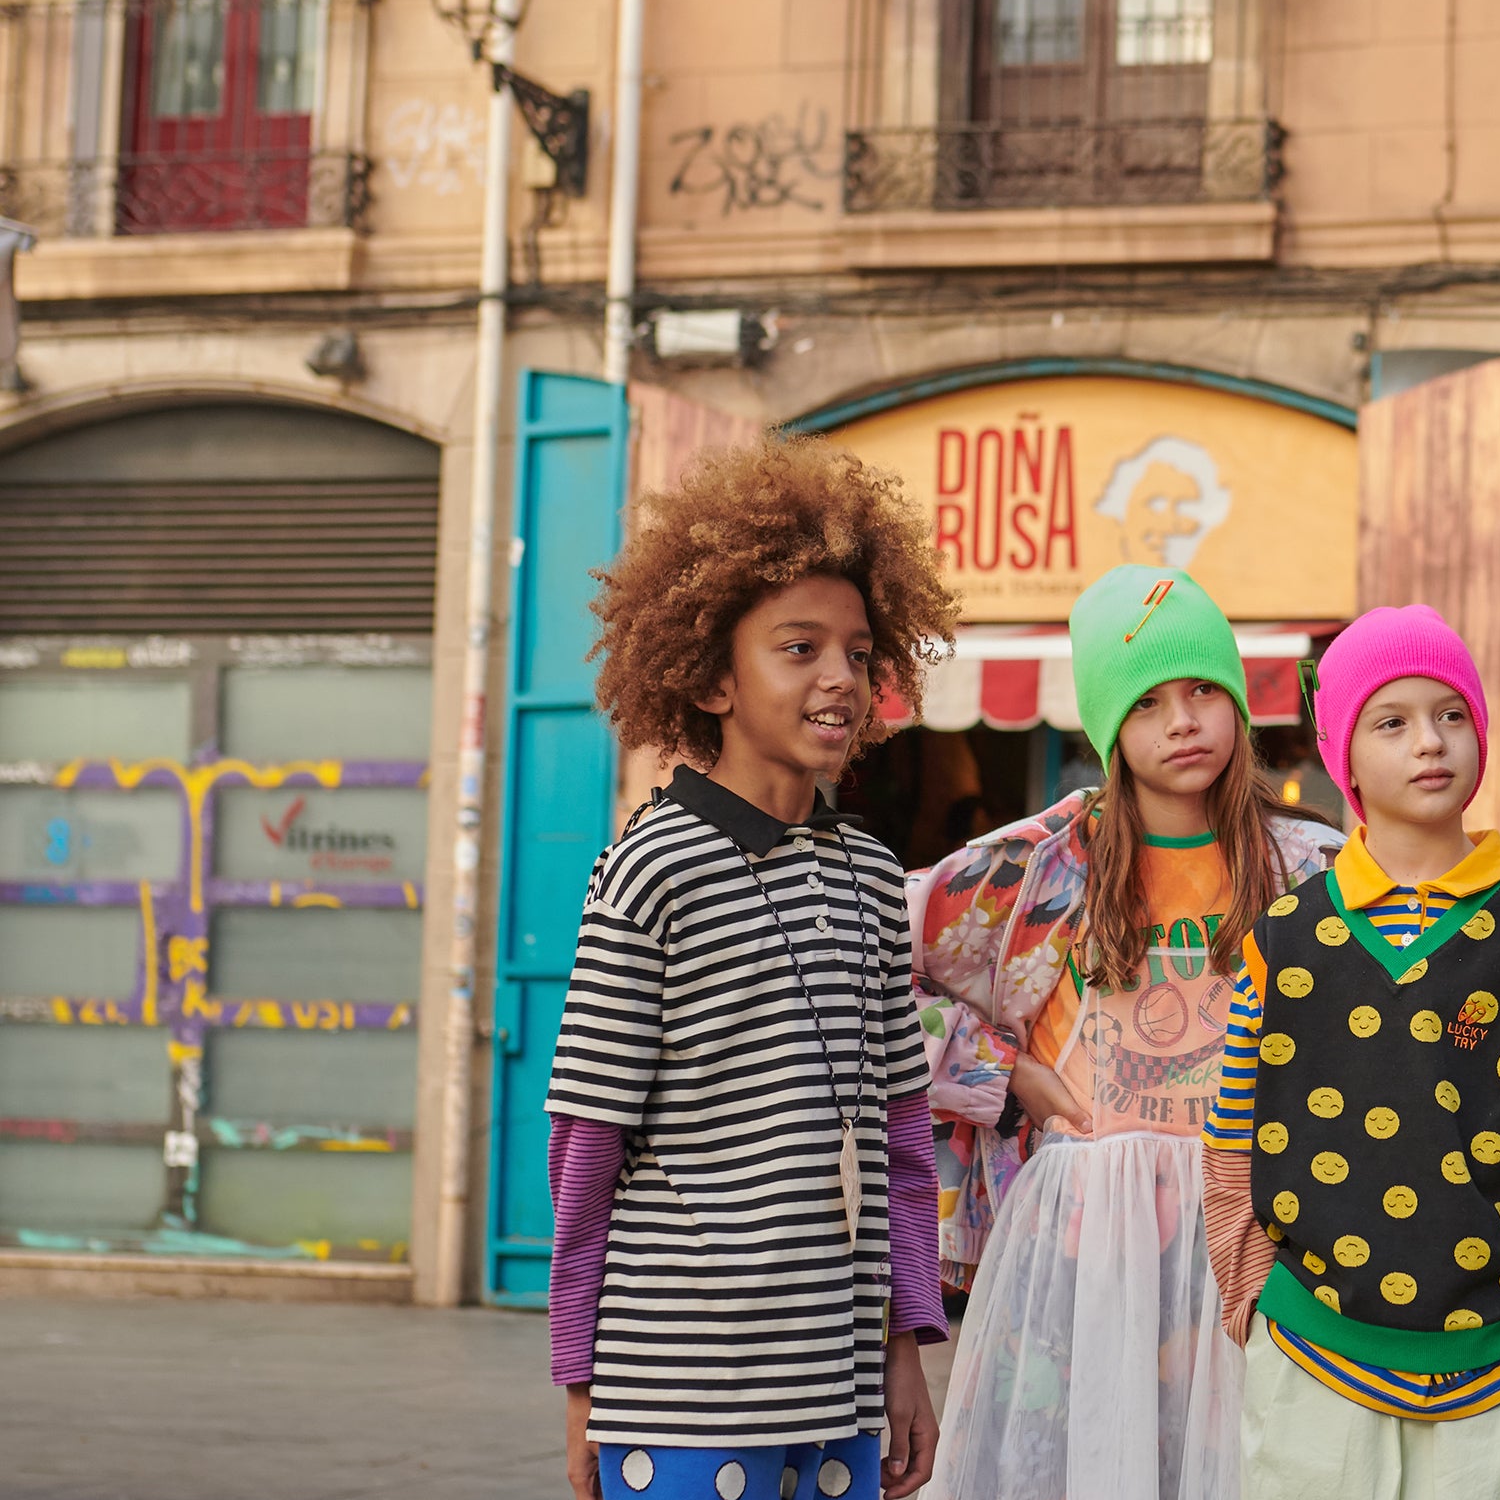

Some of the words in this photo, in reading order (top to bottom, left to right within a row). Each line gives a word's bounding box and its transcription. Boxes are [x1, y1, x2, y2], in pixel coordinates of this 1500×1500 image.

[937, 412, 1078, 497] DOÑA
[935, 502, 1080, 572] ROSA
[1447, 1022, 1488, 1040] LUCKY
[1454, 1035, 1478, 1051] TRY
